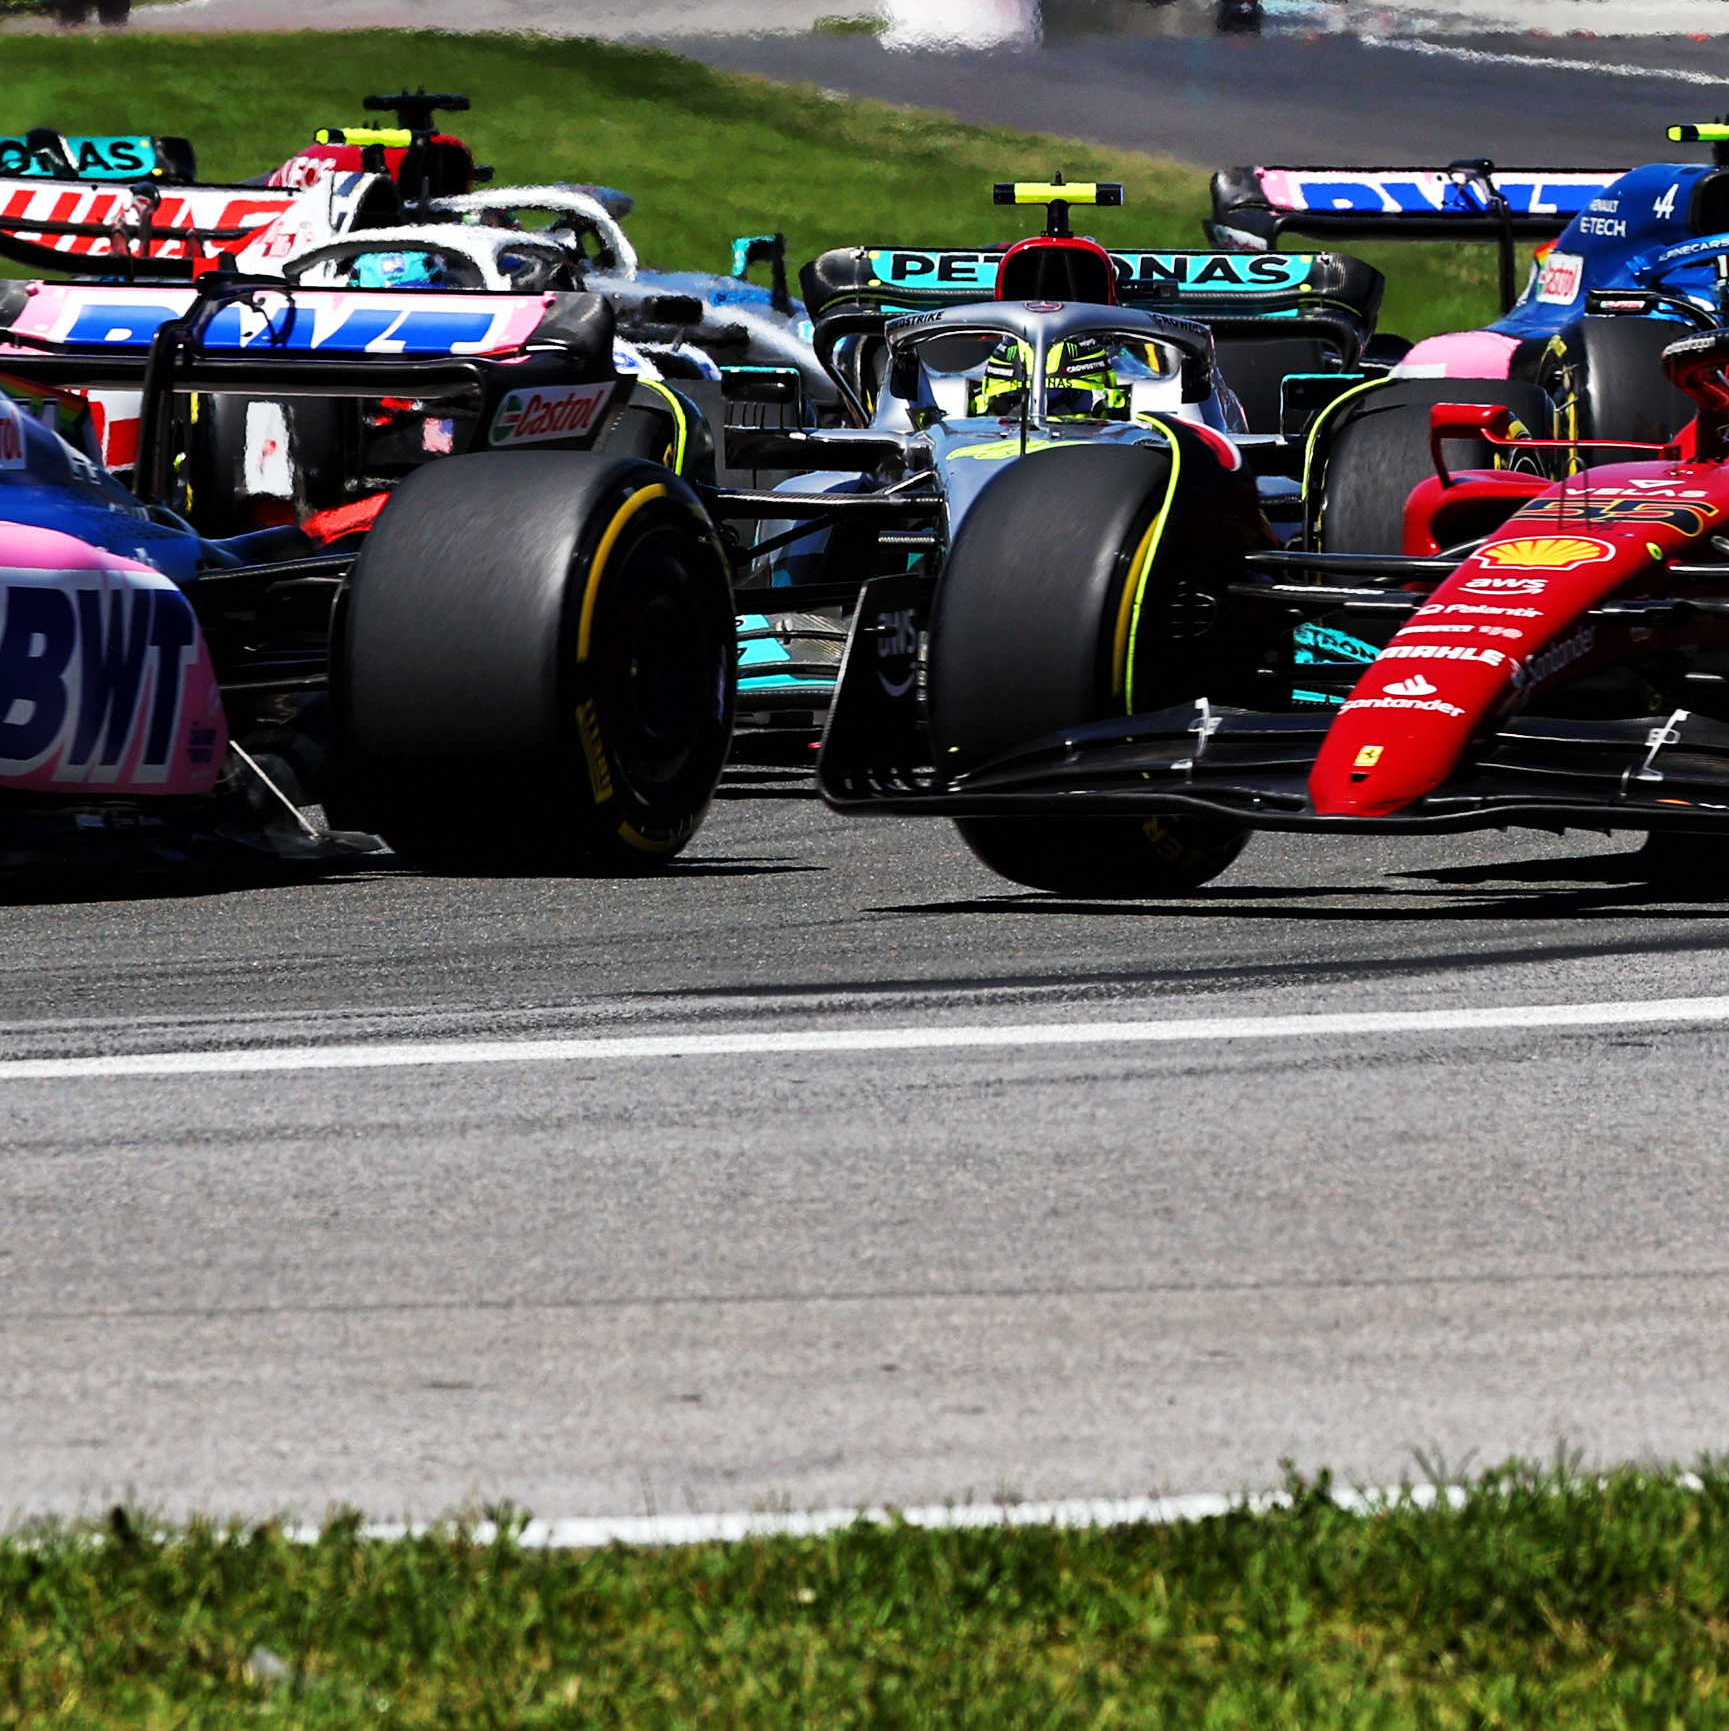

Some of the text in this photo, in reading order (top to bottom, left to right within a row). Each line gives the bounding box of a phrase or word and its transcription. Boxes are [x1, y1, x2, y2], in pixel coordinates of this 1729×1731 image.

[1580, 216, 1627, 239] E-TECH
[890, 253, 1292, 284] PENAS
[513, 388, 606, 439] Castrol
[1564, 486, 1709, 500] VELAS
[1509, 497, 1721, 538] 55
[1465, 577, 1550, 589] aws
[1443, 603, 1545, 618] Palantir
[1373, 645, 1507, 667] MAHLE
